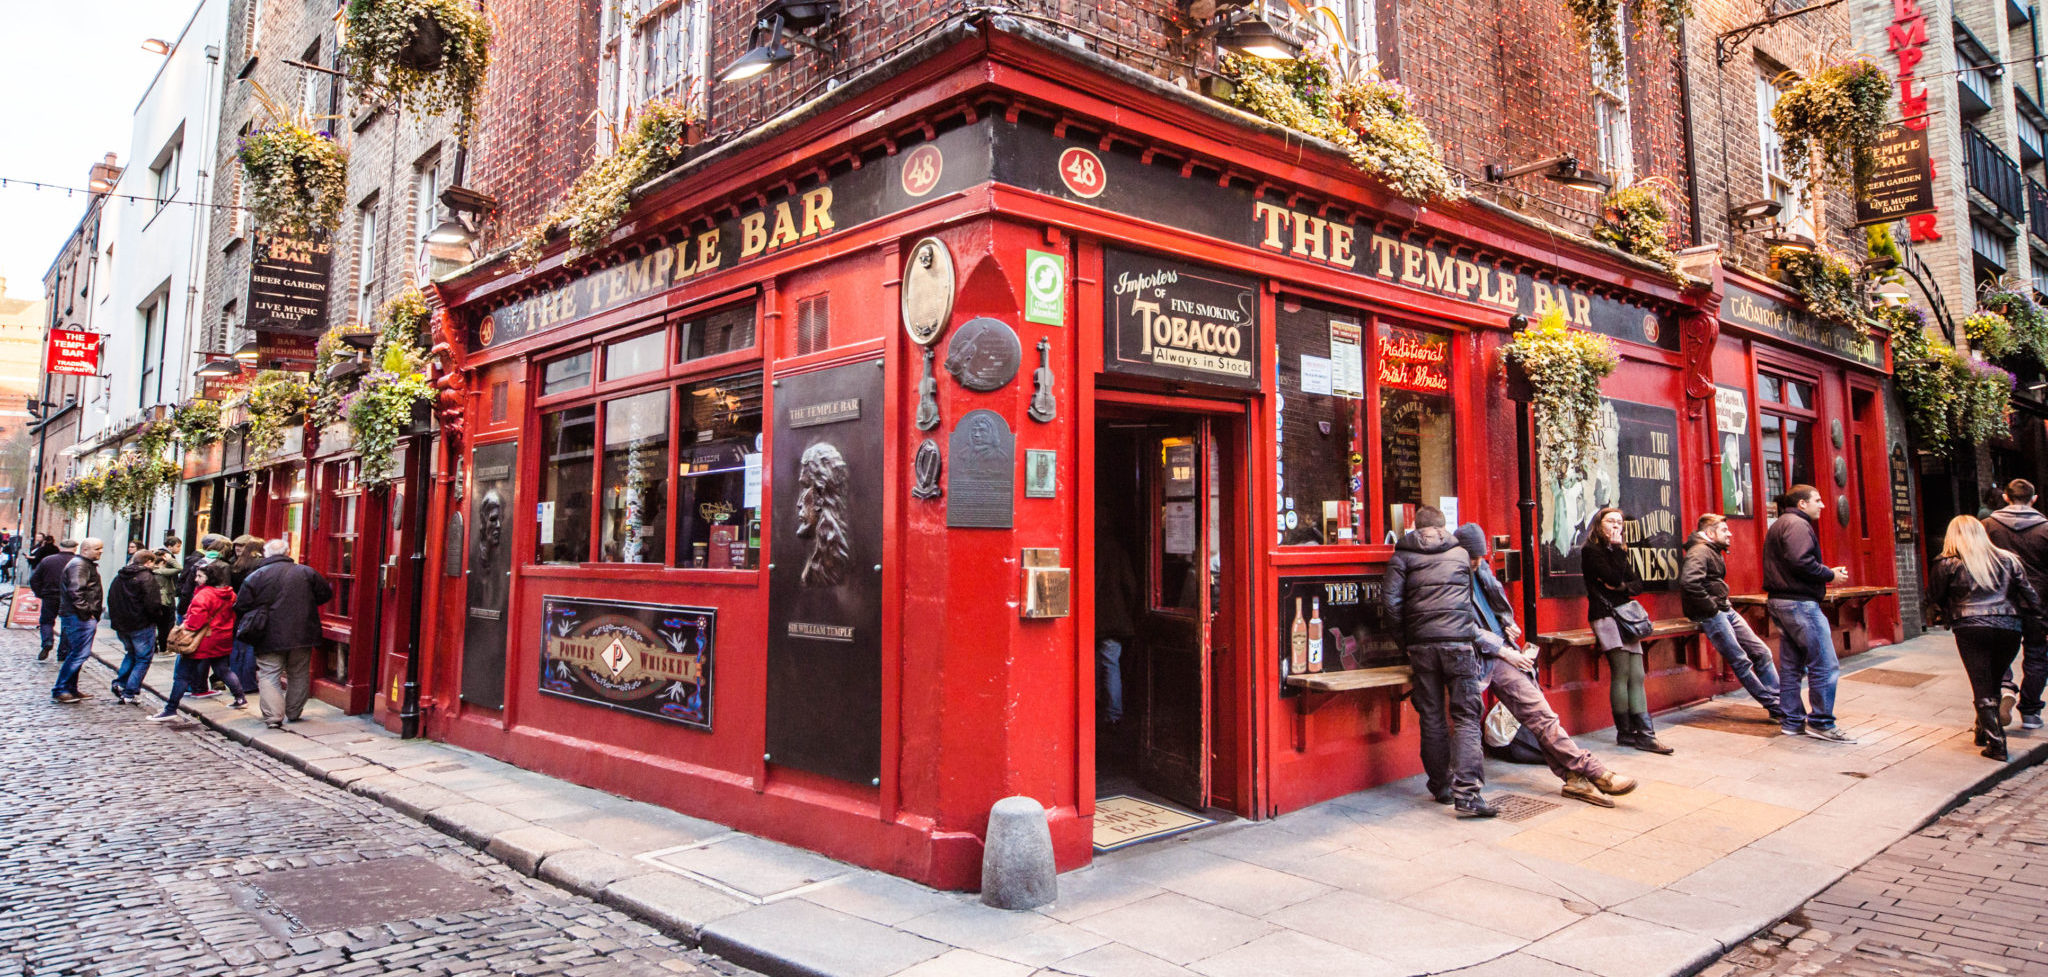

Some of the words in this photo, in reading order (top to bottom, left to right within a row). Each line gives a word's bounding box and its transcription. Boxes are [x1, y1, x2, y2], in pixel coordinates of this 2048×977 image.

[1879, 129, 1899, 141] THE
[908, 154, 935, 188] 48
[1067, 154, 1097, 187] 48
[1886, 174, 1922, 187] GARDEN
[1869, 201, 1889, 210] LIVE
[1891, 195, 1918, 206] MUSIC
[1882, 203, 1906, 214] DAILY
[269, 243, 312, 265] BAR
[525, 285, 578, 331] THE
[586, 228, 722, 311] TEMPLE
[739, 186, 836, 259] BAR
[1256, 201, 1356, 268] THE
[1372, 235, 1520, 308] TEMPLE
[1533, 281, 1592, 328] BAR
[253, 275, 281, 285] BEER
[283, 279, 326, 291] GARDEN
[1113, 268, 1178, 300] Importers
[1154, 287, 1167, 298] OF
[255, 301, 281, 311] LIVE
[284, 304, 318, 316] MUSIC
[271, 310, 303, 321] DAILY
[1171, 298, 1195, 315] FINE
[1195, 303, 1241, 323] SMOKING
[65, 332, 86, 341] THE
[482, 321, 492, 341] 48
[1131, 298, 1241, 356] TOBACCO
[1645, 321, 1657, 338] 48
[54, 339, 95, 350] TEMPLE
[259, 346, 316, 357] MERCHANDISE
[277, 338, 297, 346] BAR
[1379, 336, 1443, 361] Traditional
[62, 349, 85, 357] BAR
[1156, 348, 1198, 366] Always
[1203, 357, 1214, 368] in
[1218, 357, 1249, 374] Stock
[54, 365, 89, 373] COMPANY
[1378, 359, 1408, 383] Irish
[1412, 365, 1447, 390] Music
[789, 408, 804, 420] THE
[807, 402, 839, 418] TEMPLE
[840, 398, 858, 412] BAR
[1650, 431, 1670, 455] THE
[1628, 455, 1671, 482] EMPEROR
[1661, 485, 1672, 507] OF
[1641, 509, 1676, 540] LIQUORS
[1325, 583, 1359, 605] THE
[826, 626, 853, 637] TEMPLE
[640, 652, 691, 677] WHISKEY
[1110, 818, 1168, 835] BAR
